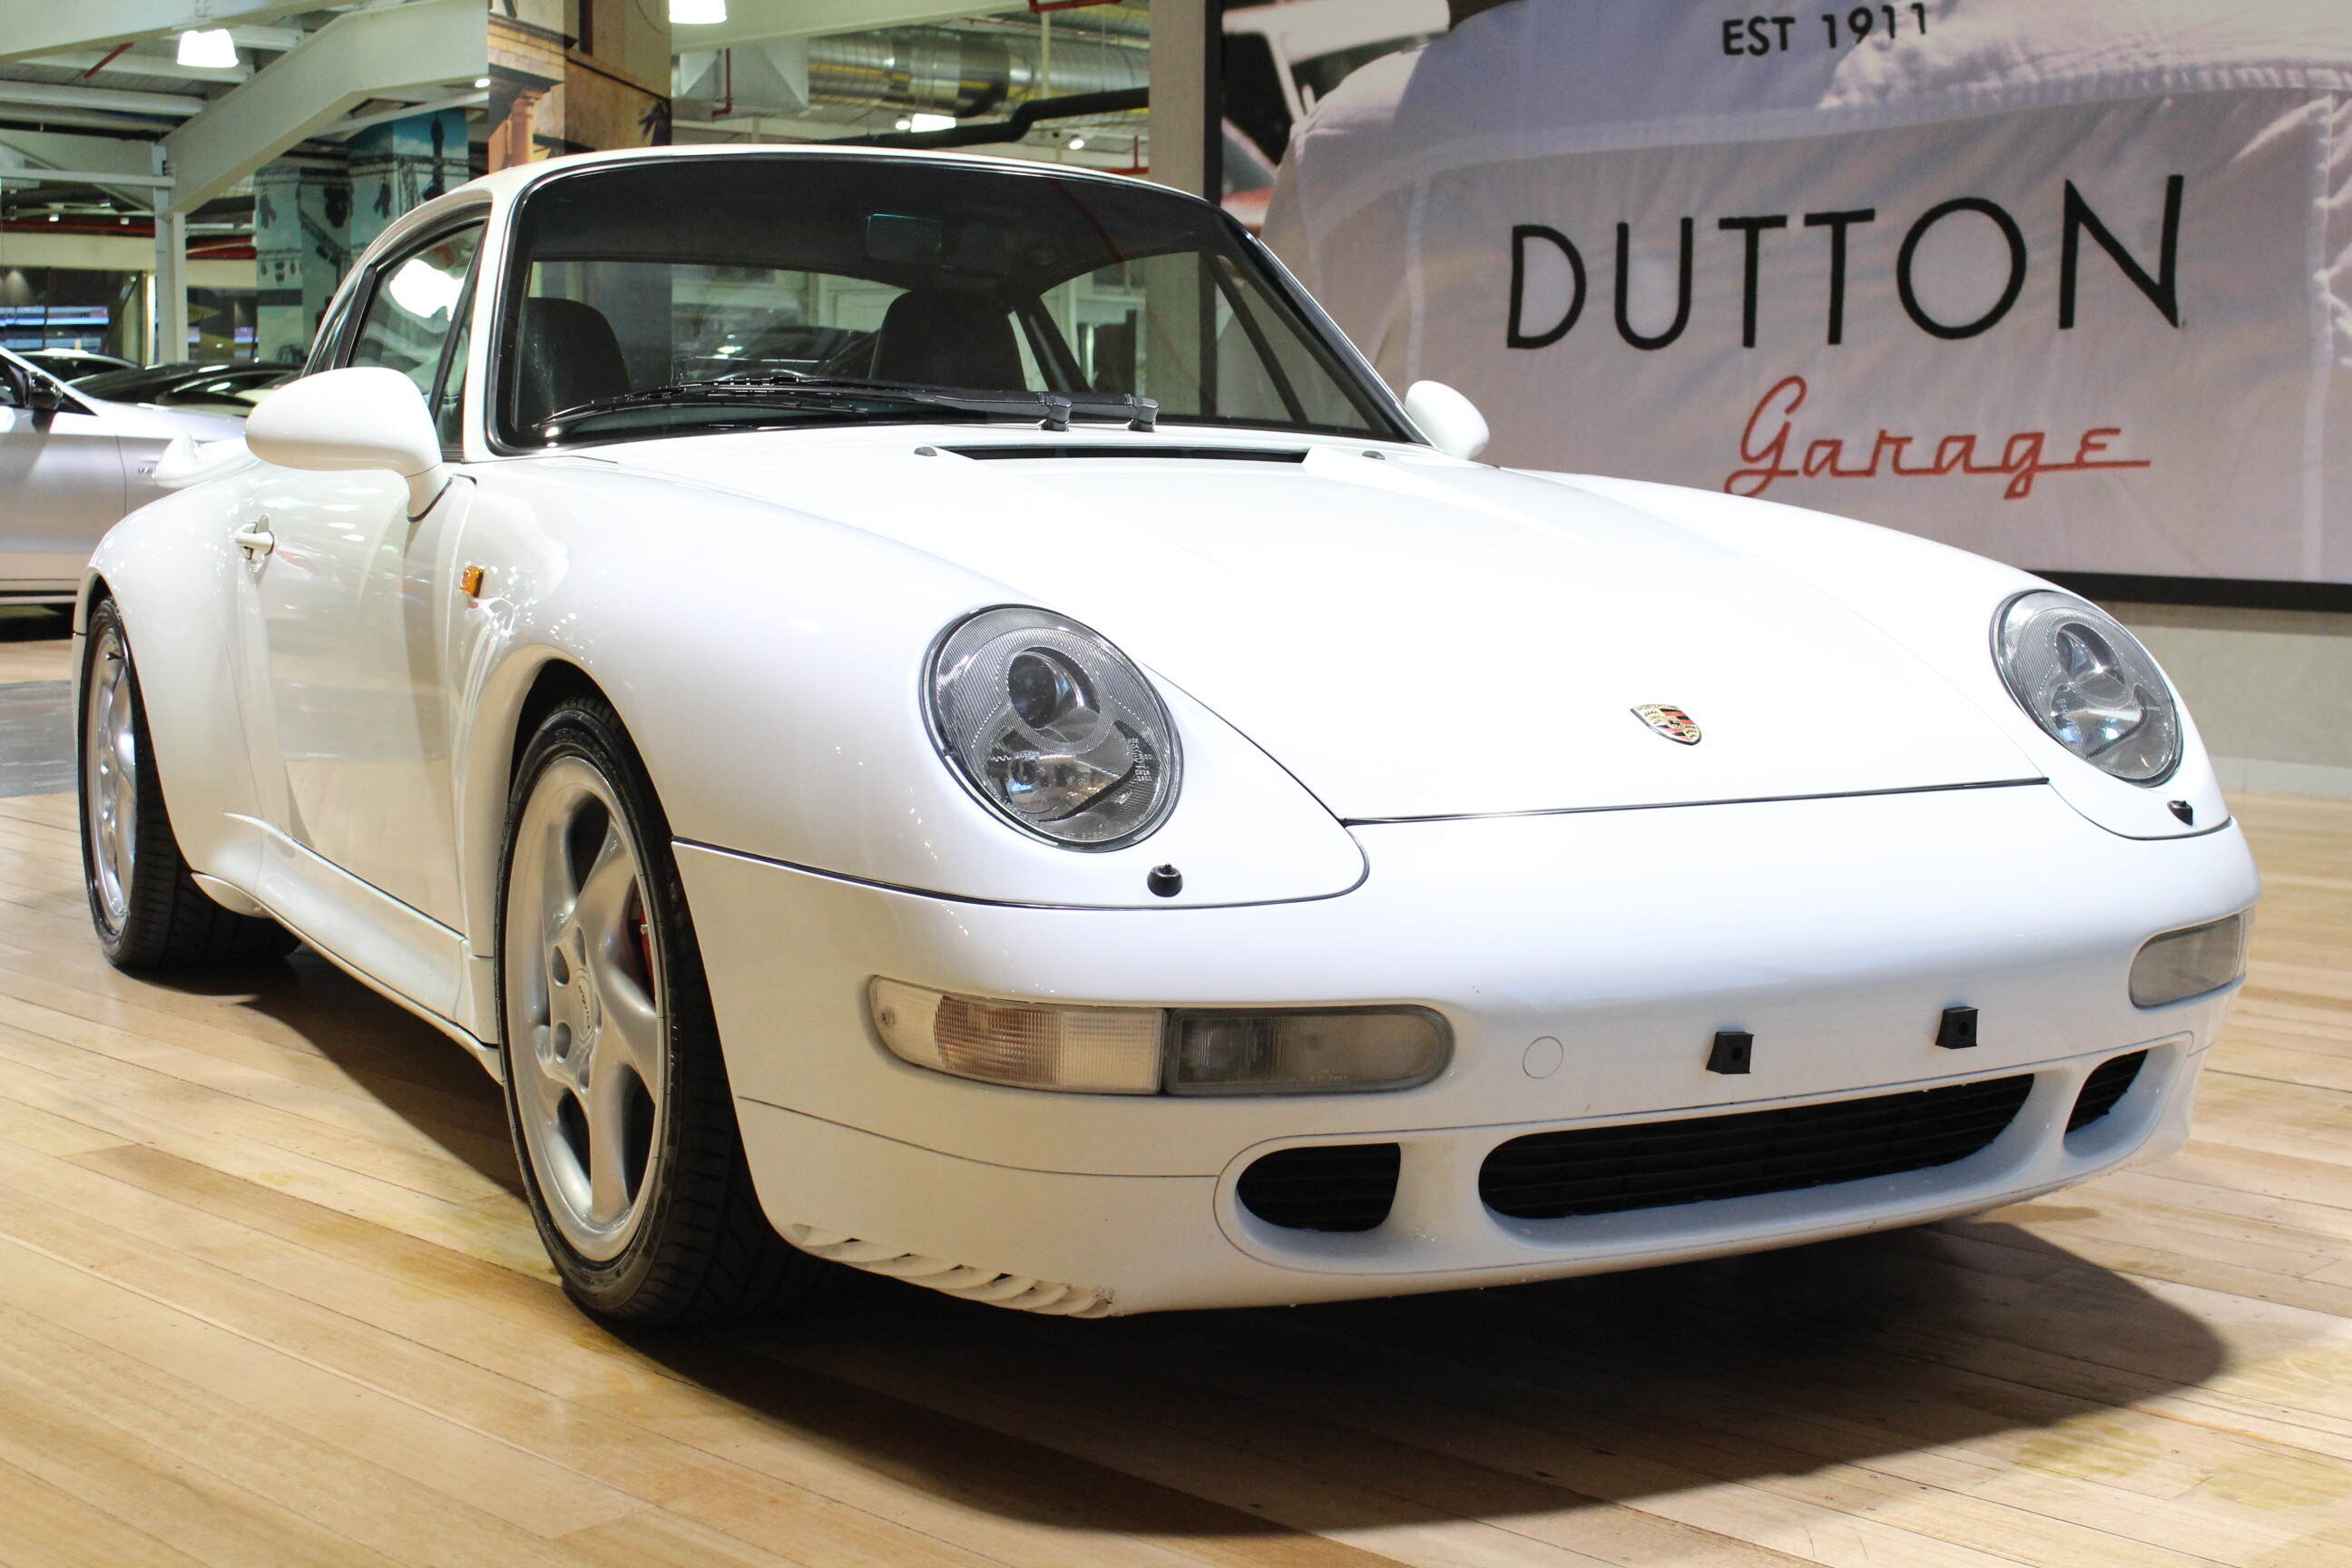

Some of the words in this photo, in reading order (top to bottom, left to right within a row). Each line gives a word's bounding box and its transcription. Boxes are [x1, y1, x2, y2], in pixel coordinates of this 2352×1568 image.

[1722, 15, 1796, 56] EST
[1821, 3, 1926, 48] 1911
[1506, 174, 2184, 350] DUTTON
[1724, 375, 2151, 500] Garage
